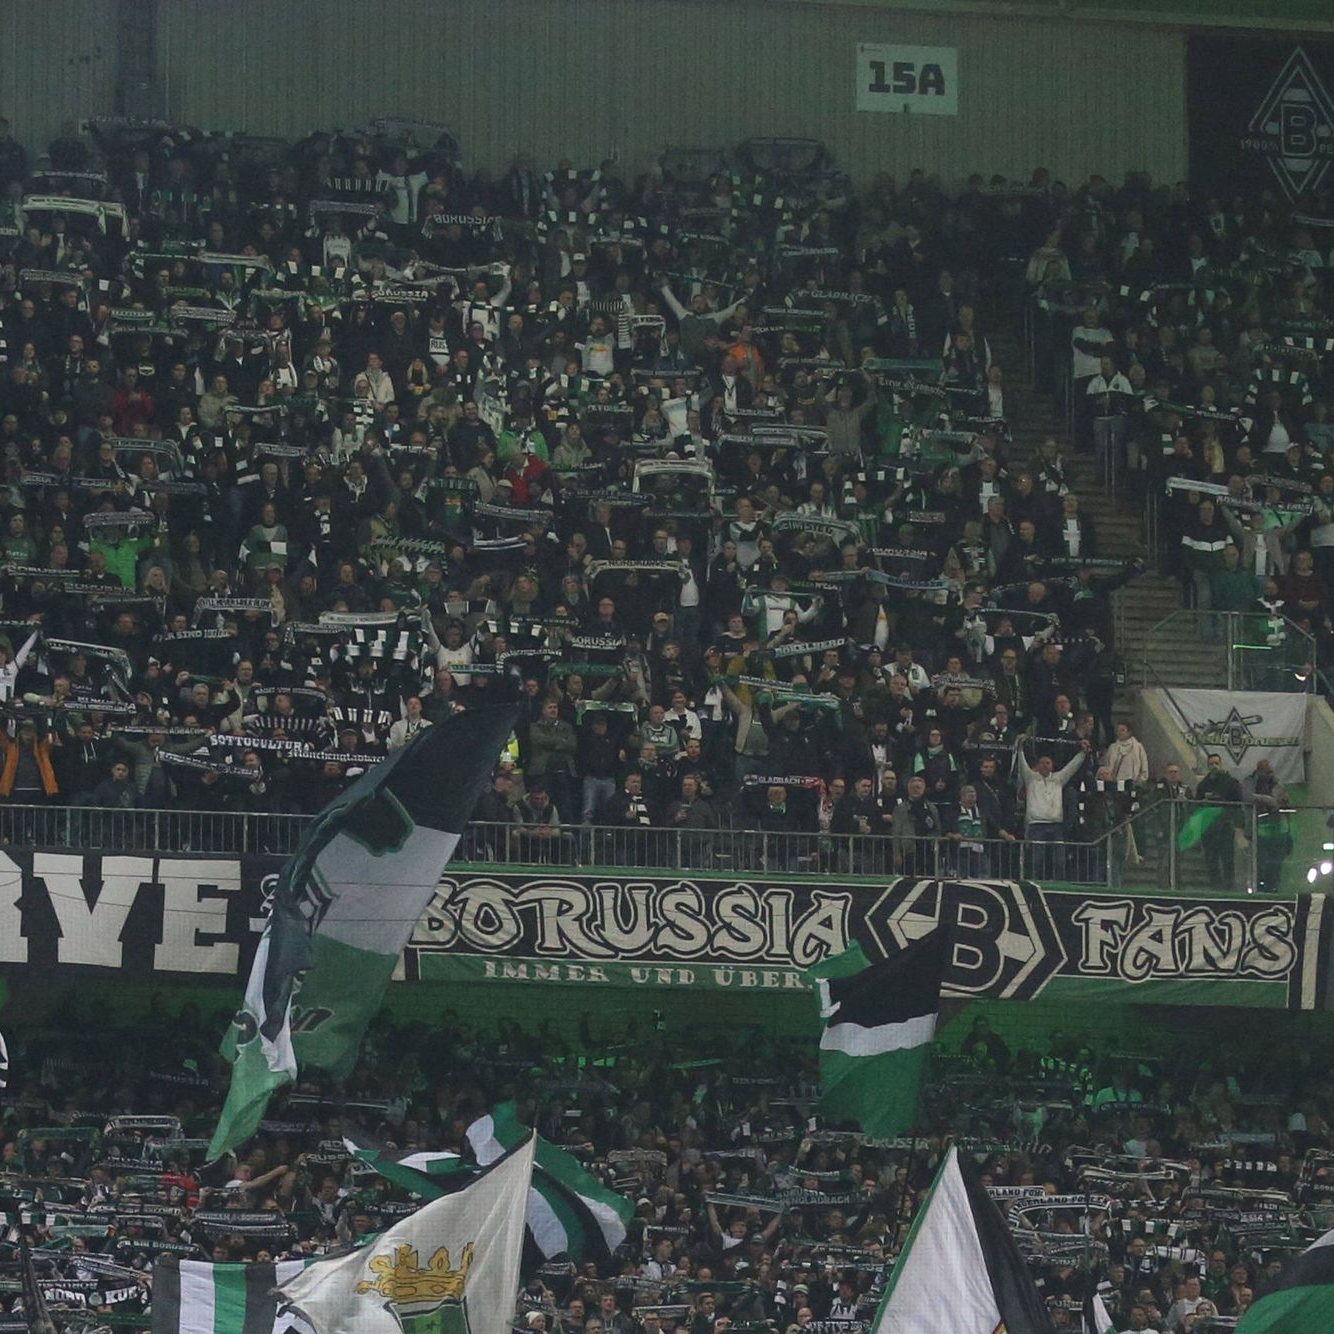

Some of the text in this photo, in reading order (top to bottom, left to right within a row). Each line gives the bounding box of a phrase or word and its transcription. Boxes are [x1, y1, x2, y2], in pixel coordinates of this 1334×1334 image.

[867, 61, 946, 96] 15A
[210, 734, 309, 752] SOTTOCULTURA
[410, 878, 854, 969] BORUSSIA
[1072, 901, 1295, 981] FANS
[483, 961, 813, 989] IMMER UND ÜBER
[44, 1287, 86, 1304] NORD
